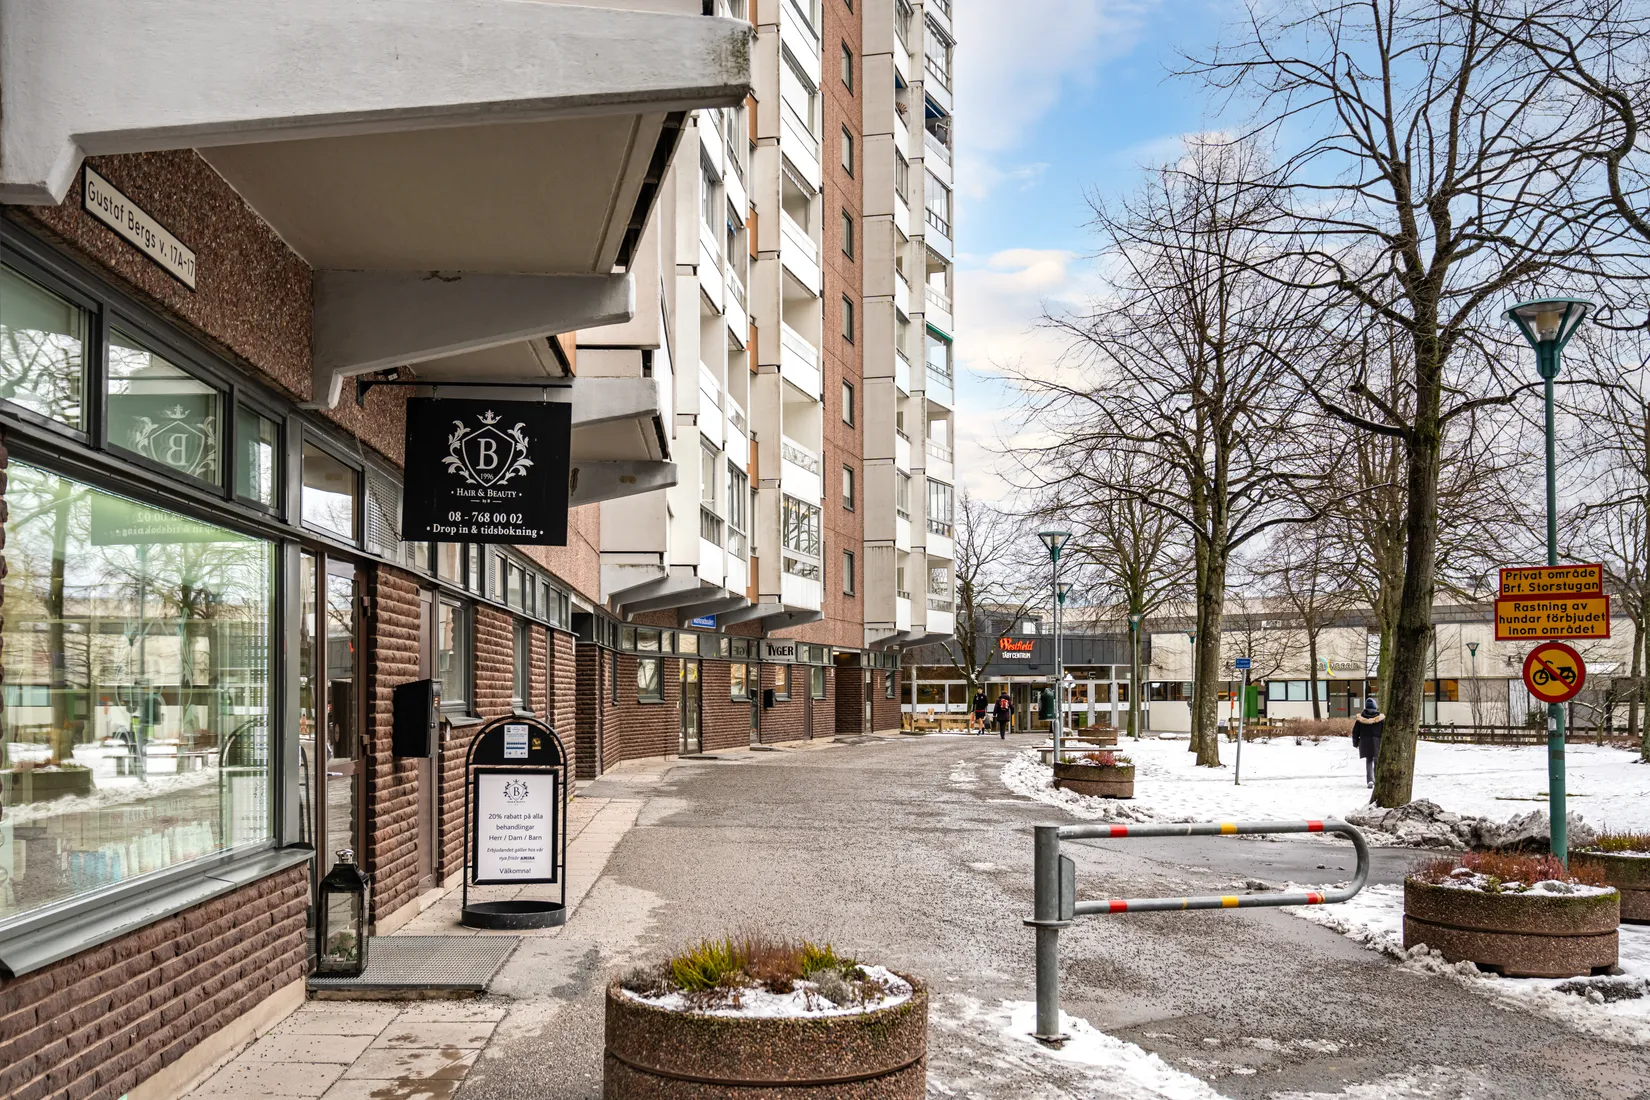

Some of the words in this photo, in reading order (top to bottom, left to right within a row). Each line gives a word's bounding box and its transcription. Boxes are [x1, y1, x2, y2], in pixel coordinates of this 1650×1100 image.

[88, 181, 124, 222] Gustaf
[128, 211, 155, 248] Bergs
[159, 239, 167, 257] v.
[170, 245, 194, 276] 17A-17
[476, 438, 498, 470] B
[457, 488, 476, 496] HAIR
[488, 490, 516, 498] BEAUTY
[448, 512, 461, 521] 08
[472, 512, 490, 522] 768
[493, 513, 506, 523] 00
[510, 514, 523, 523] 02
[433, 524, 456, 535] Drop
[459, 525, 468, 533] in
[481, 526, 537, 538] tidsbokning
[1506, 570, 1542, 581] Privat
[1548, 568, 1595, 579] område
[1504, 583, 1524, 592] Brf.
[1529, 582, 1598, 592] Storstugan
[1514, 602, 1567, 612] Rastning
[1499, 615, 1541, 624] hundar
[1546, 612, 1605, 623] förbjudet
[1509, 627, 1536, 635] inom
[1542, 624, 1594, 634] området
[1000, 638, 1034, 650] Westfield
[766, 645, 793, 656] TYGER
[513, 787, 520, 796] B
